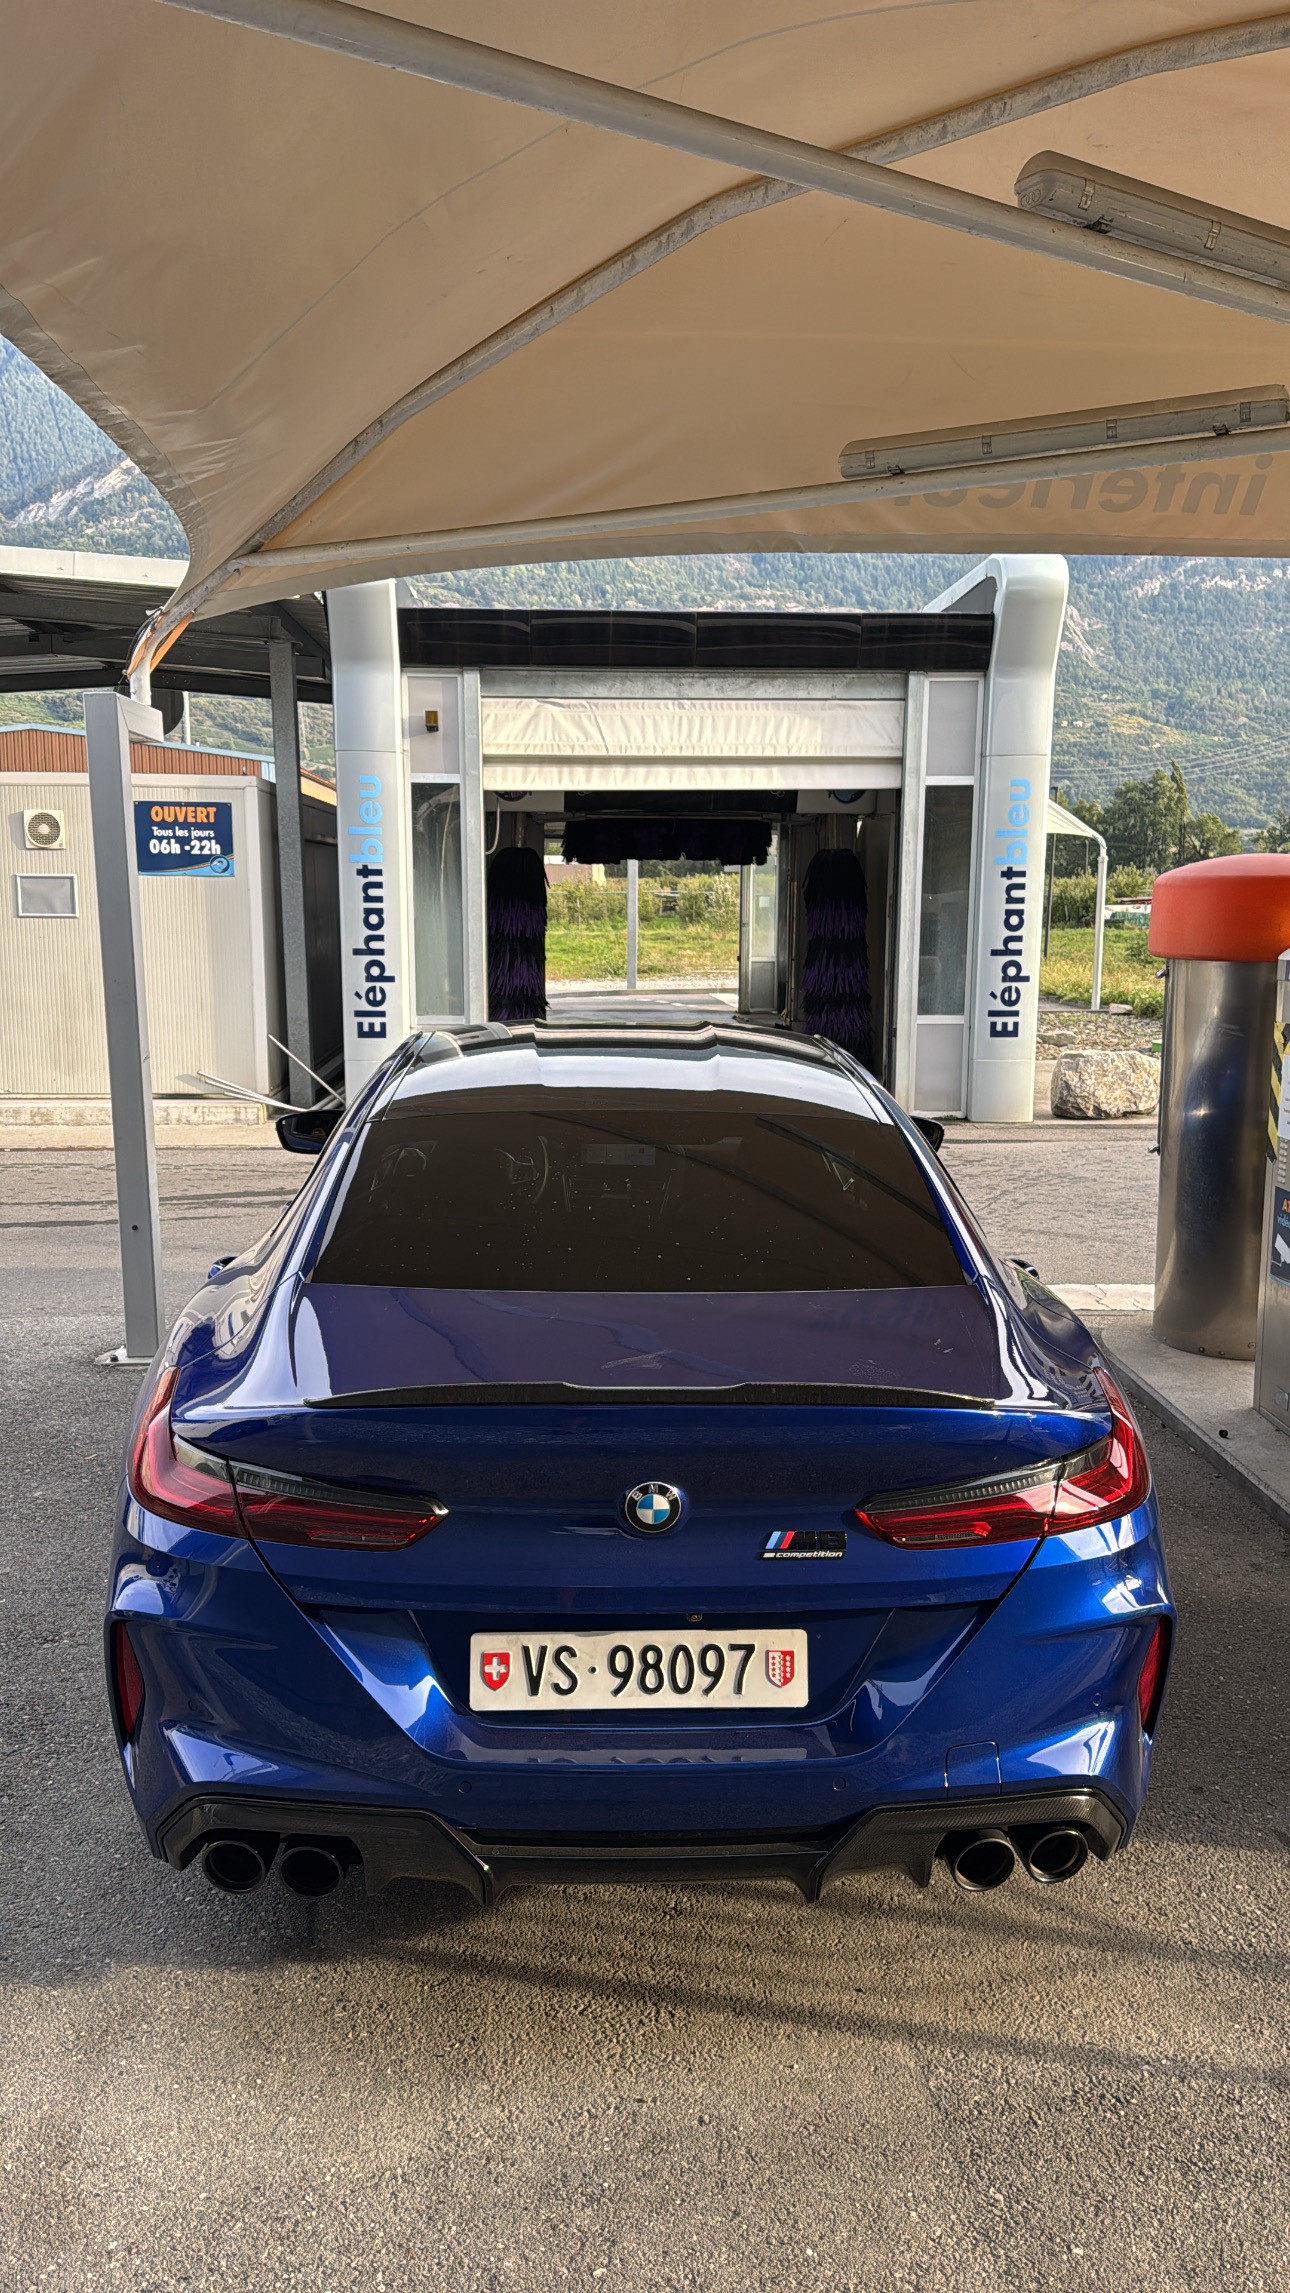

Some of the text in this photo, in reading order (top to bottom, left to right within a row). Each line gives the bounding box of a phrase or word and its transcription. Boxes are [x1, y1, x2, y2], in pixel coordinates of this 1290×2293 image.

[150, 805, 217, 823] OUVERT
[151, 826, 215, 840] Tous les jours
[149, 838, 181, 854] 06h
[631, 1484, 677, 1501] BMW
[775, 1550, 843, 1558] competition
